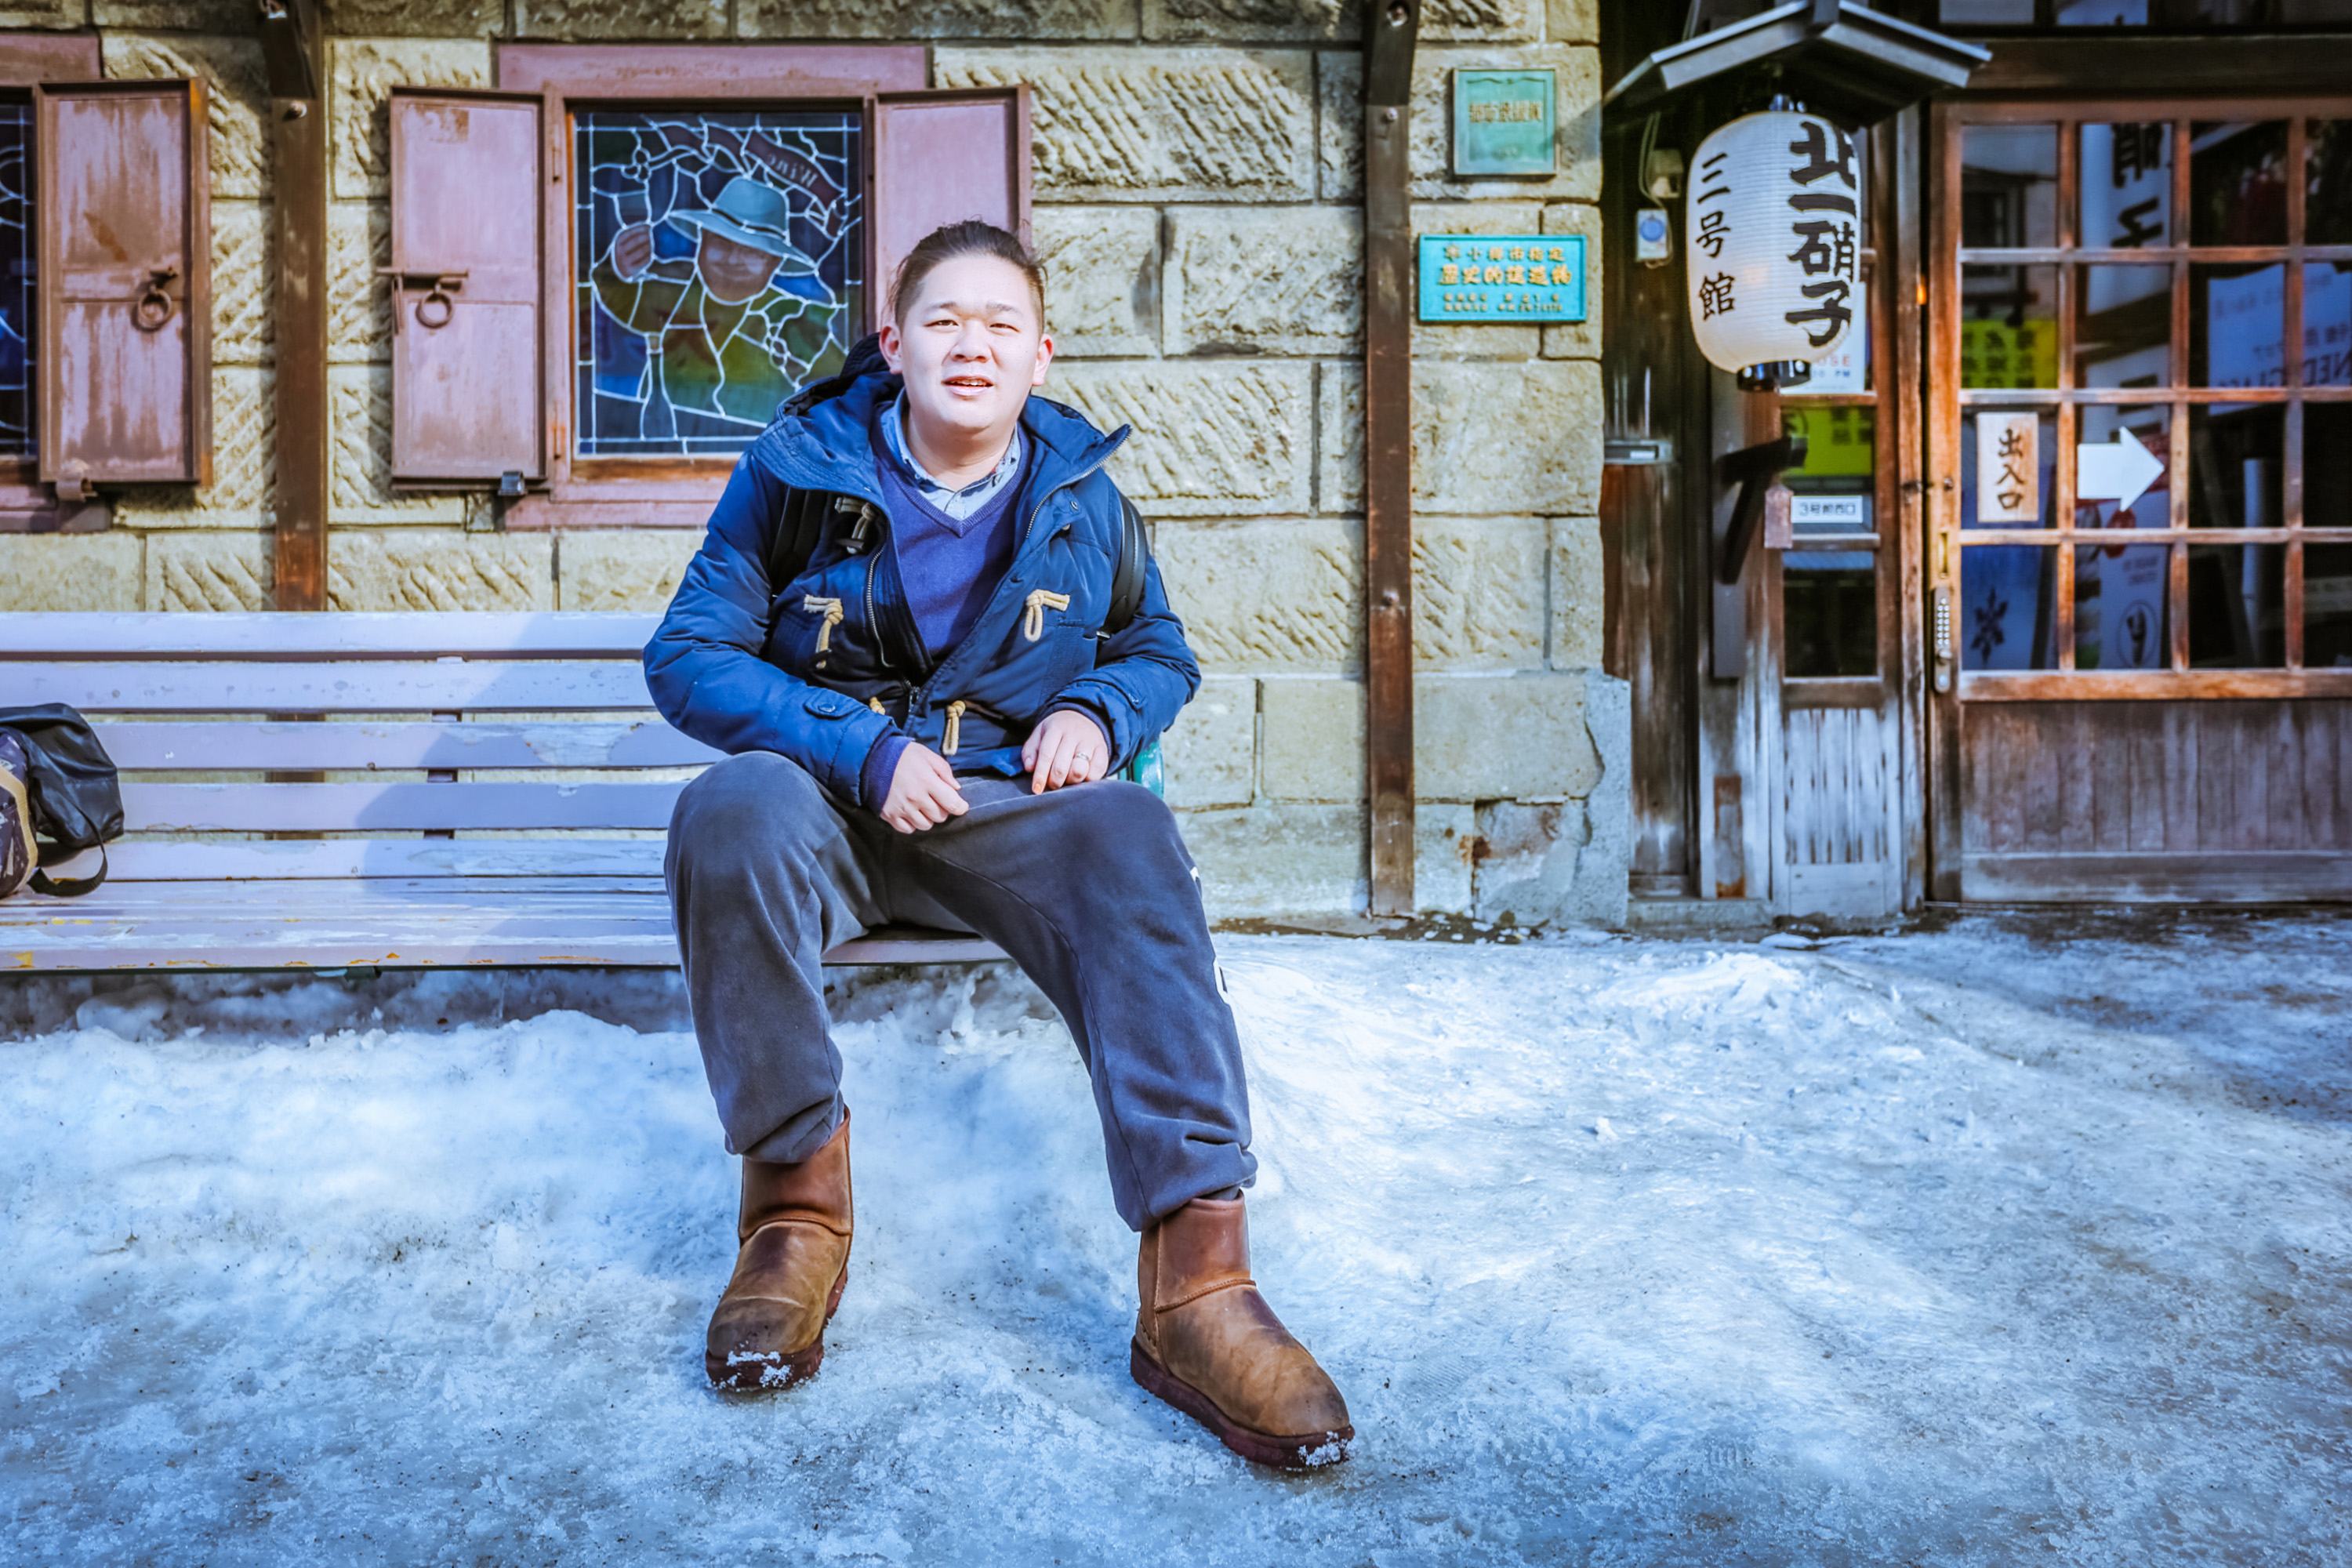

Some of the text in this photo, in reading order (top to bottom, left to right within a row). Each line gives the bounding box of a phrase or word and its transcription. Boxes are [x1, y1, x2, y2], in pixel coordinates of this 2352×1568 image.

[1695, 151, 1736, 321] 三号館
[1784, 120, 1860, 348] 北一硝子
[1995, 428, 2025, 510] 出入口
